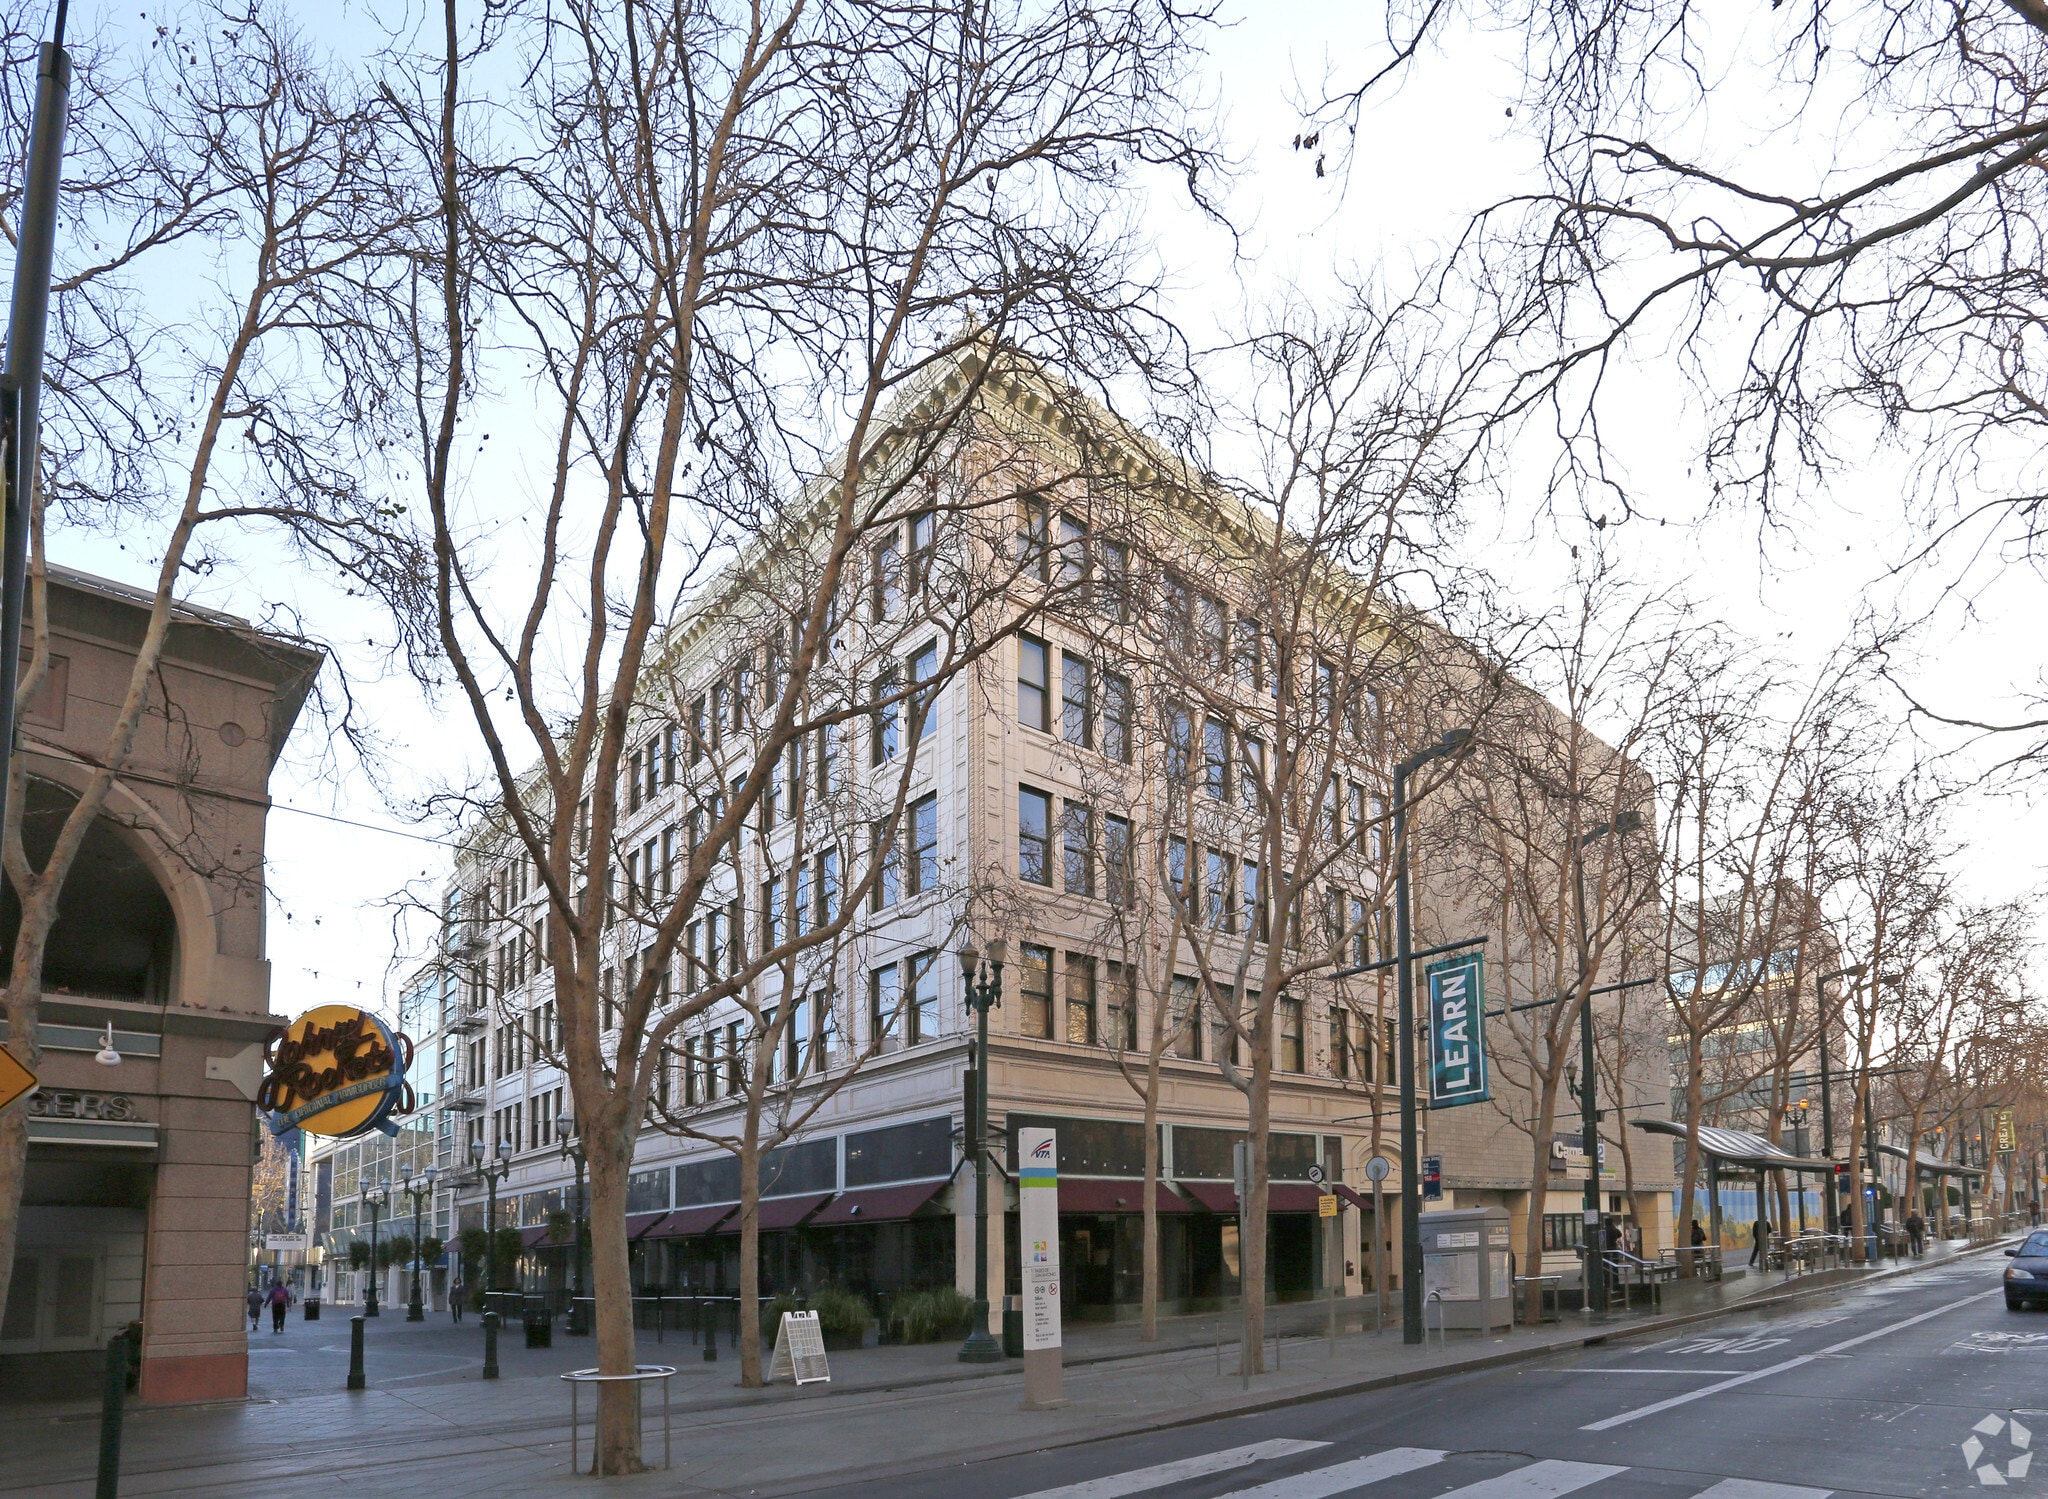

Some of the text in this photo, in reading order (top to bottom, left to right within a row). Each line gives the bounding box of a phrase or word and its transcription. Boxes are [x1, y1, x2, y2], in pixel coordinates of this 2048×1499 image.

[262, 1010, 377, 1080] Johnny
[1442, 974, 1471, 1089] LEARN
[262, 1041, 396, 1113] Rockets
[294, 1095, 333, 1118] ORIGINAL
